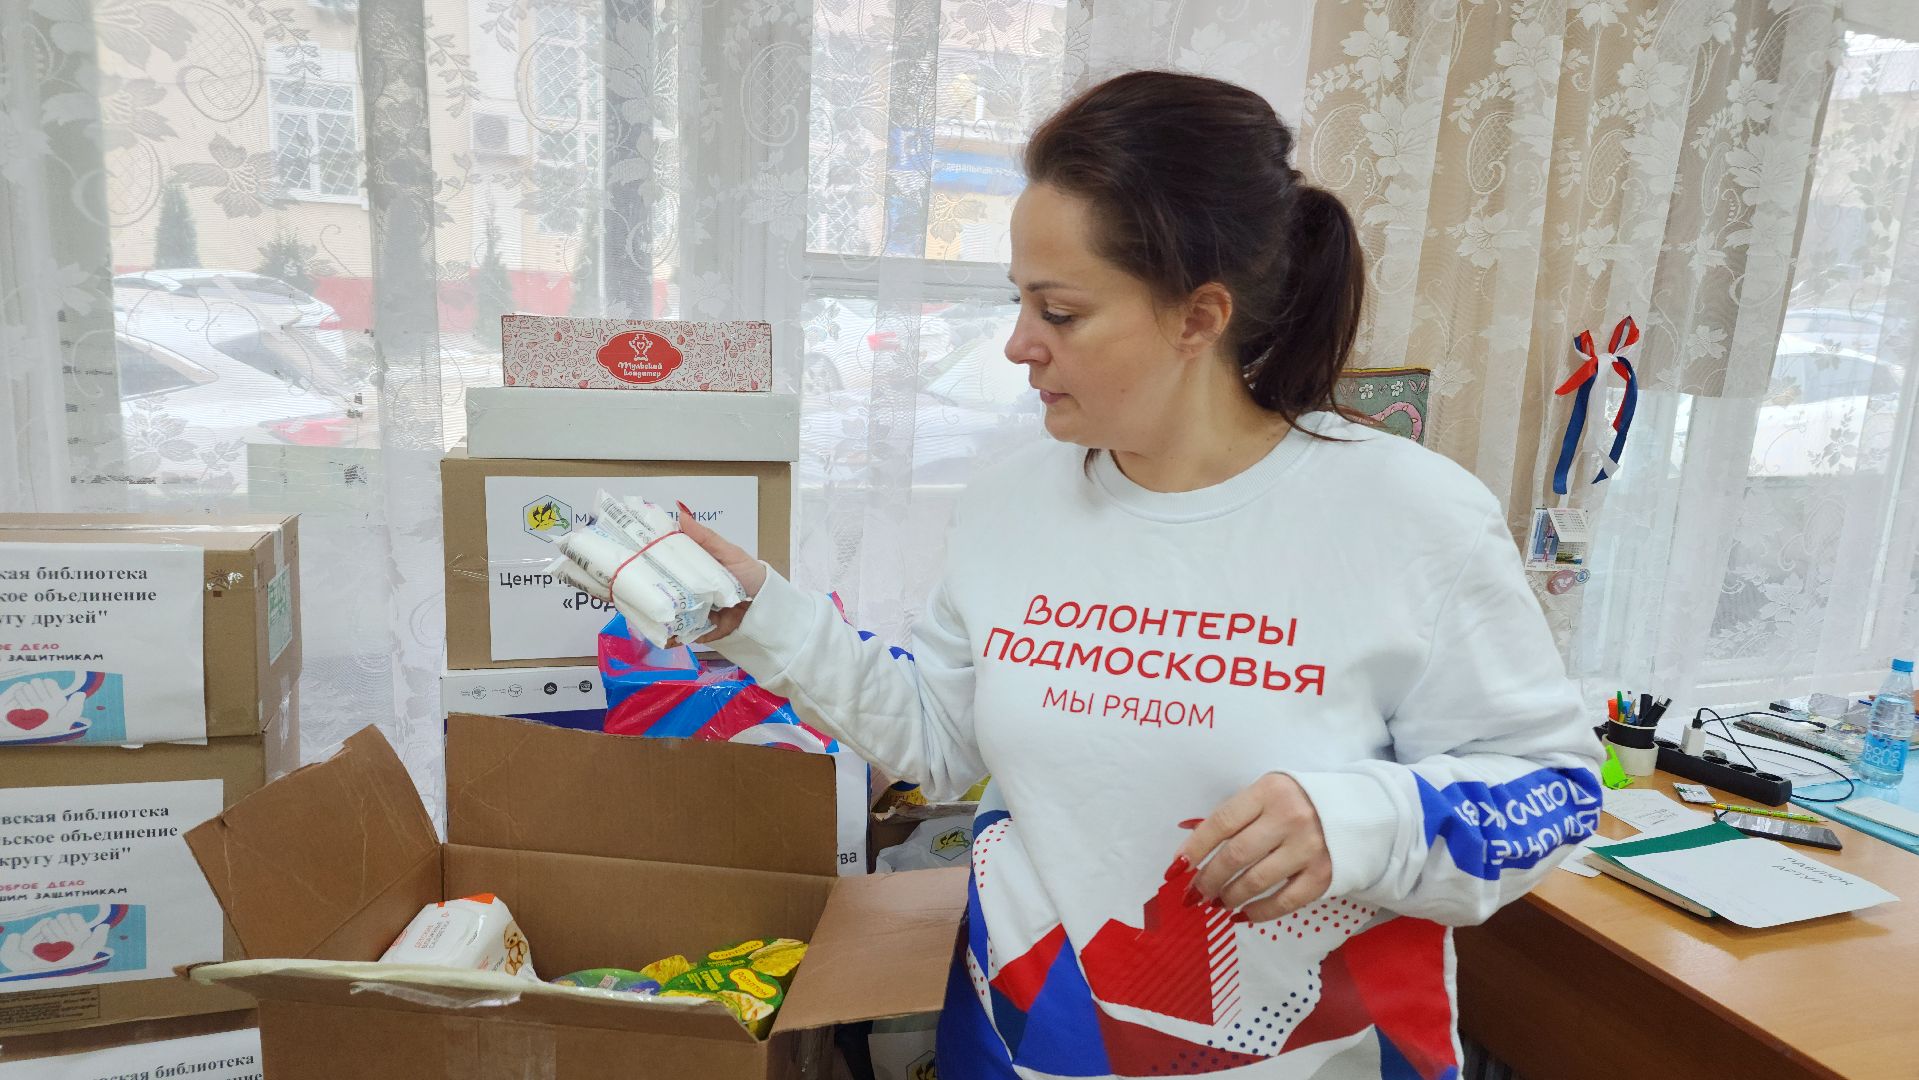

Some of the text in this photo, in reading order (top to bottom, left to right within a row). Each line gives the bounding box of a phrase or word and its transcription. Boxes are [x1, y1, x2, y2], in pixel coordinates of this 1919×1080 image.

[36, 566, 148, 580] библиотека
[500, 572, 553, 588] Центр
[34, 588, 158, 602] объединение
[1024, 594, 1298, 647] ВОЛОНТЕРЫ
[20, 643, 60, 651] ДЕЛО
[8, 653, 104, 661] ЗАЩИТНИКАМ
[983, 627, 1326, 696] ПОДМОСКОВЬЯ
[1042, 687, 1215, 729] МЫ РЯДОМ
[62, 806, 169, 822] библиотека
[60, 825, 178, 844] объединение
[837, 851, 857, 865] ва
[47, 880, 85, 889] ДЕЛО
[35, 887, 128, 900] ЗАЩИТНИКАМ
[154, 1055, 254, 1080] библиотека
